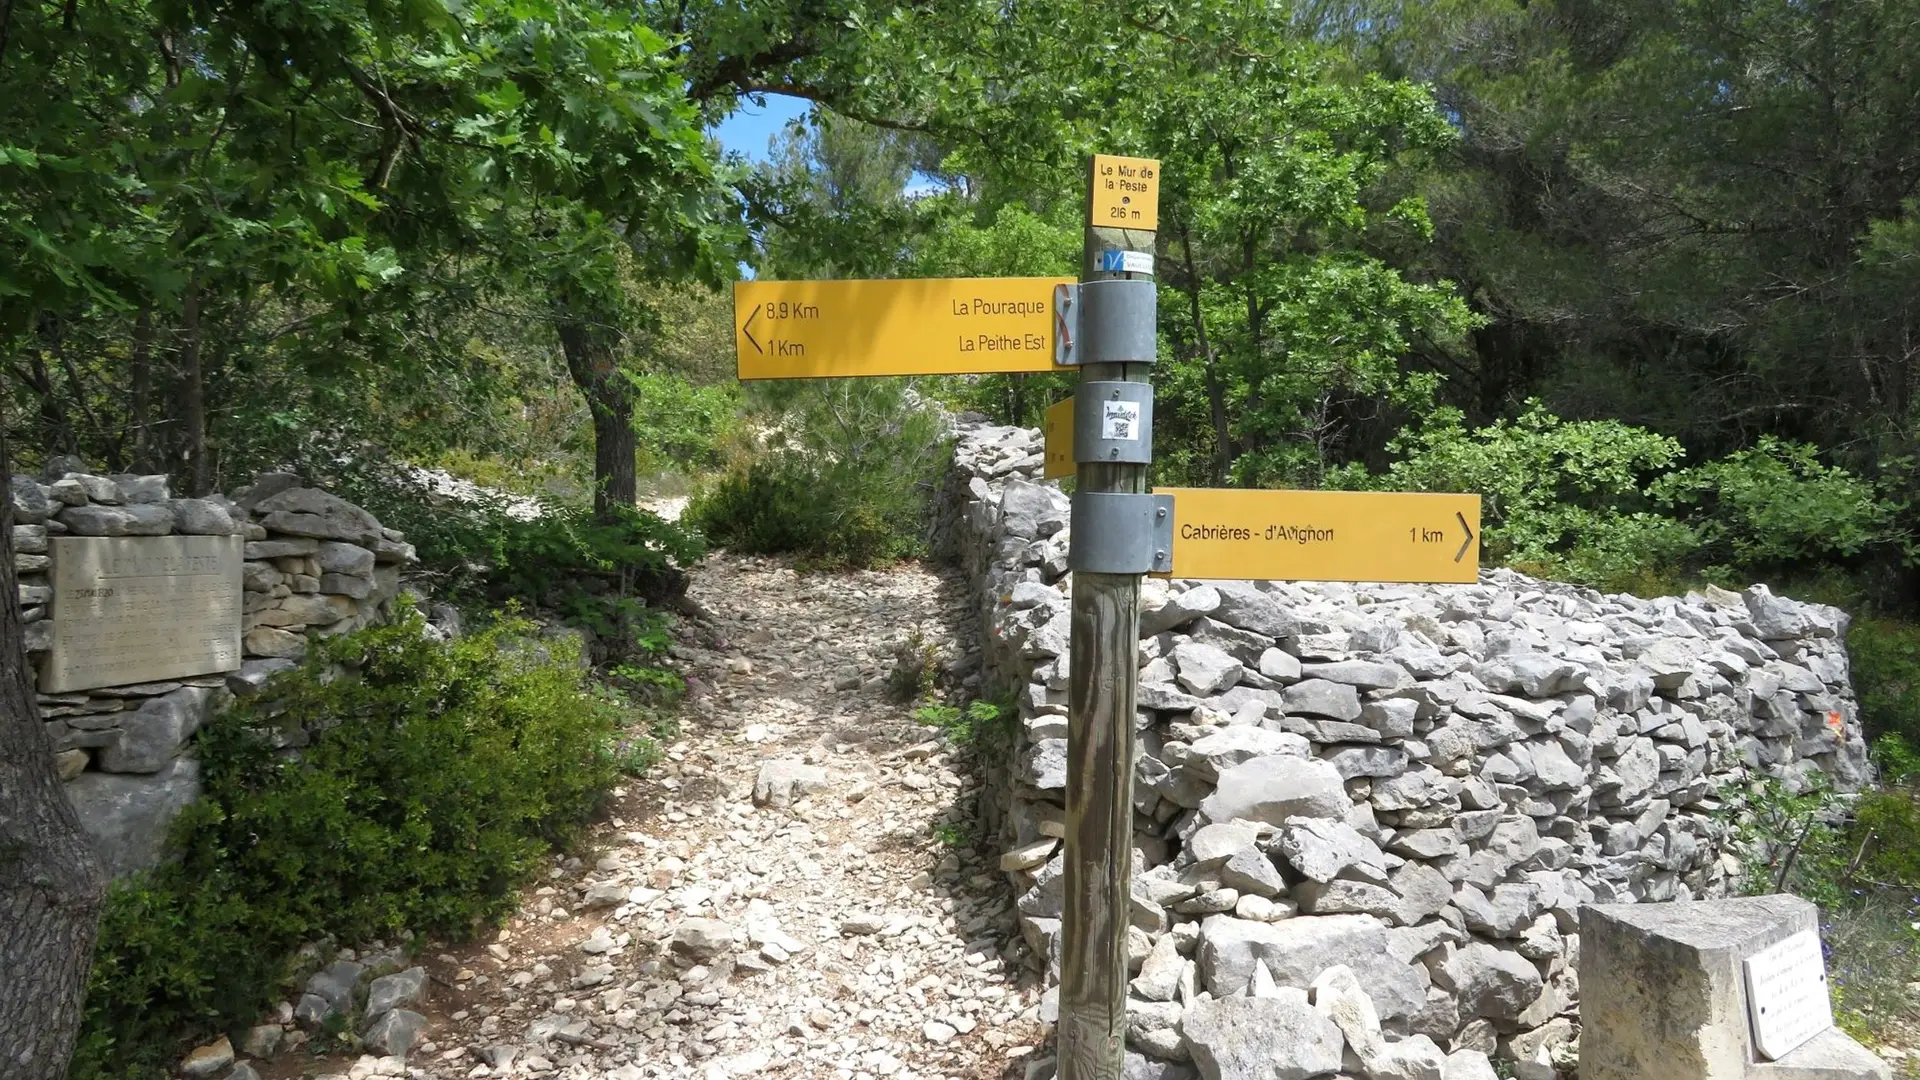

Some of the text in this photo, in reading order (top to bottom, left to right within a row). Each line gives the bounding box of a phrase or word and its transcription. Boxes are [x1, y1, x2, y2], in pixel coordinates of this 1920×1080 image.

[1101, 163, 1154, 180] Le Mur de
[1105, 178, 1148, 193] la Peste
[1110, 206, 1141, 220] 216 m
[793, 302, 819, 319] Km
[952, 298, 1045, 318] La Pouraque
[768, 339, 805, 357] 1 Km
[959, 333, 1046, 353] La Peithe Est
[1181, 523, 1251, 541] Cabrières
[1265, 525, 1334, 545] d'Avignon
[1409, 527, 1444, 544] 1 km
